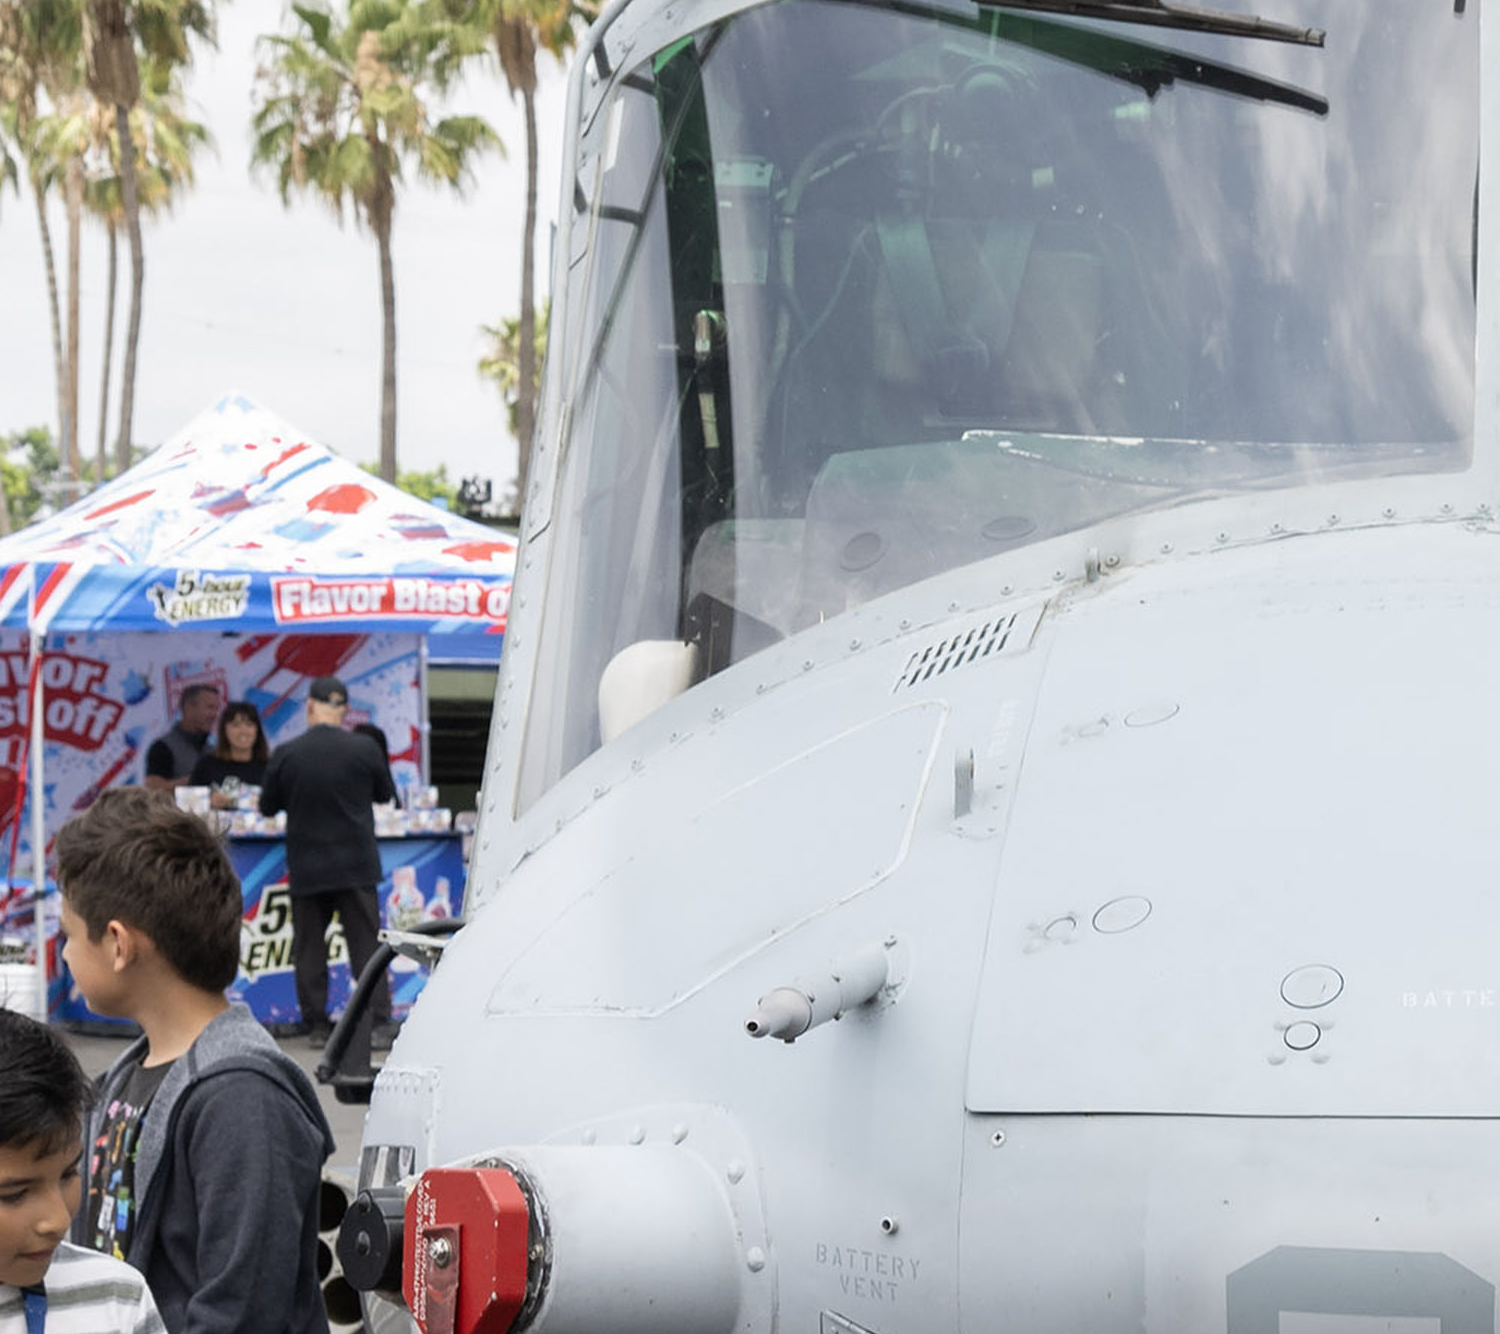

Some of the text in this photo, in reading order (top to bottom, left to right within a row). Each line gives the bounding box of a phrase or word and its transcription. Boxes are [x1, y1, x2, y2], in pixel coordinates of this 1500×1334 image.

[278, 581, 387, 618] Flavor
[394, 579, 479, 614] Blast
[47, 697, 120, 743] off
[815, 1241, 921, 1280] BATTERY
[840, 1273, 898, 1302] VENT
